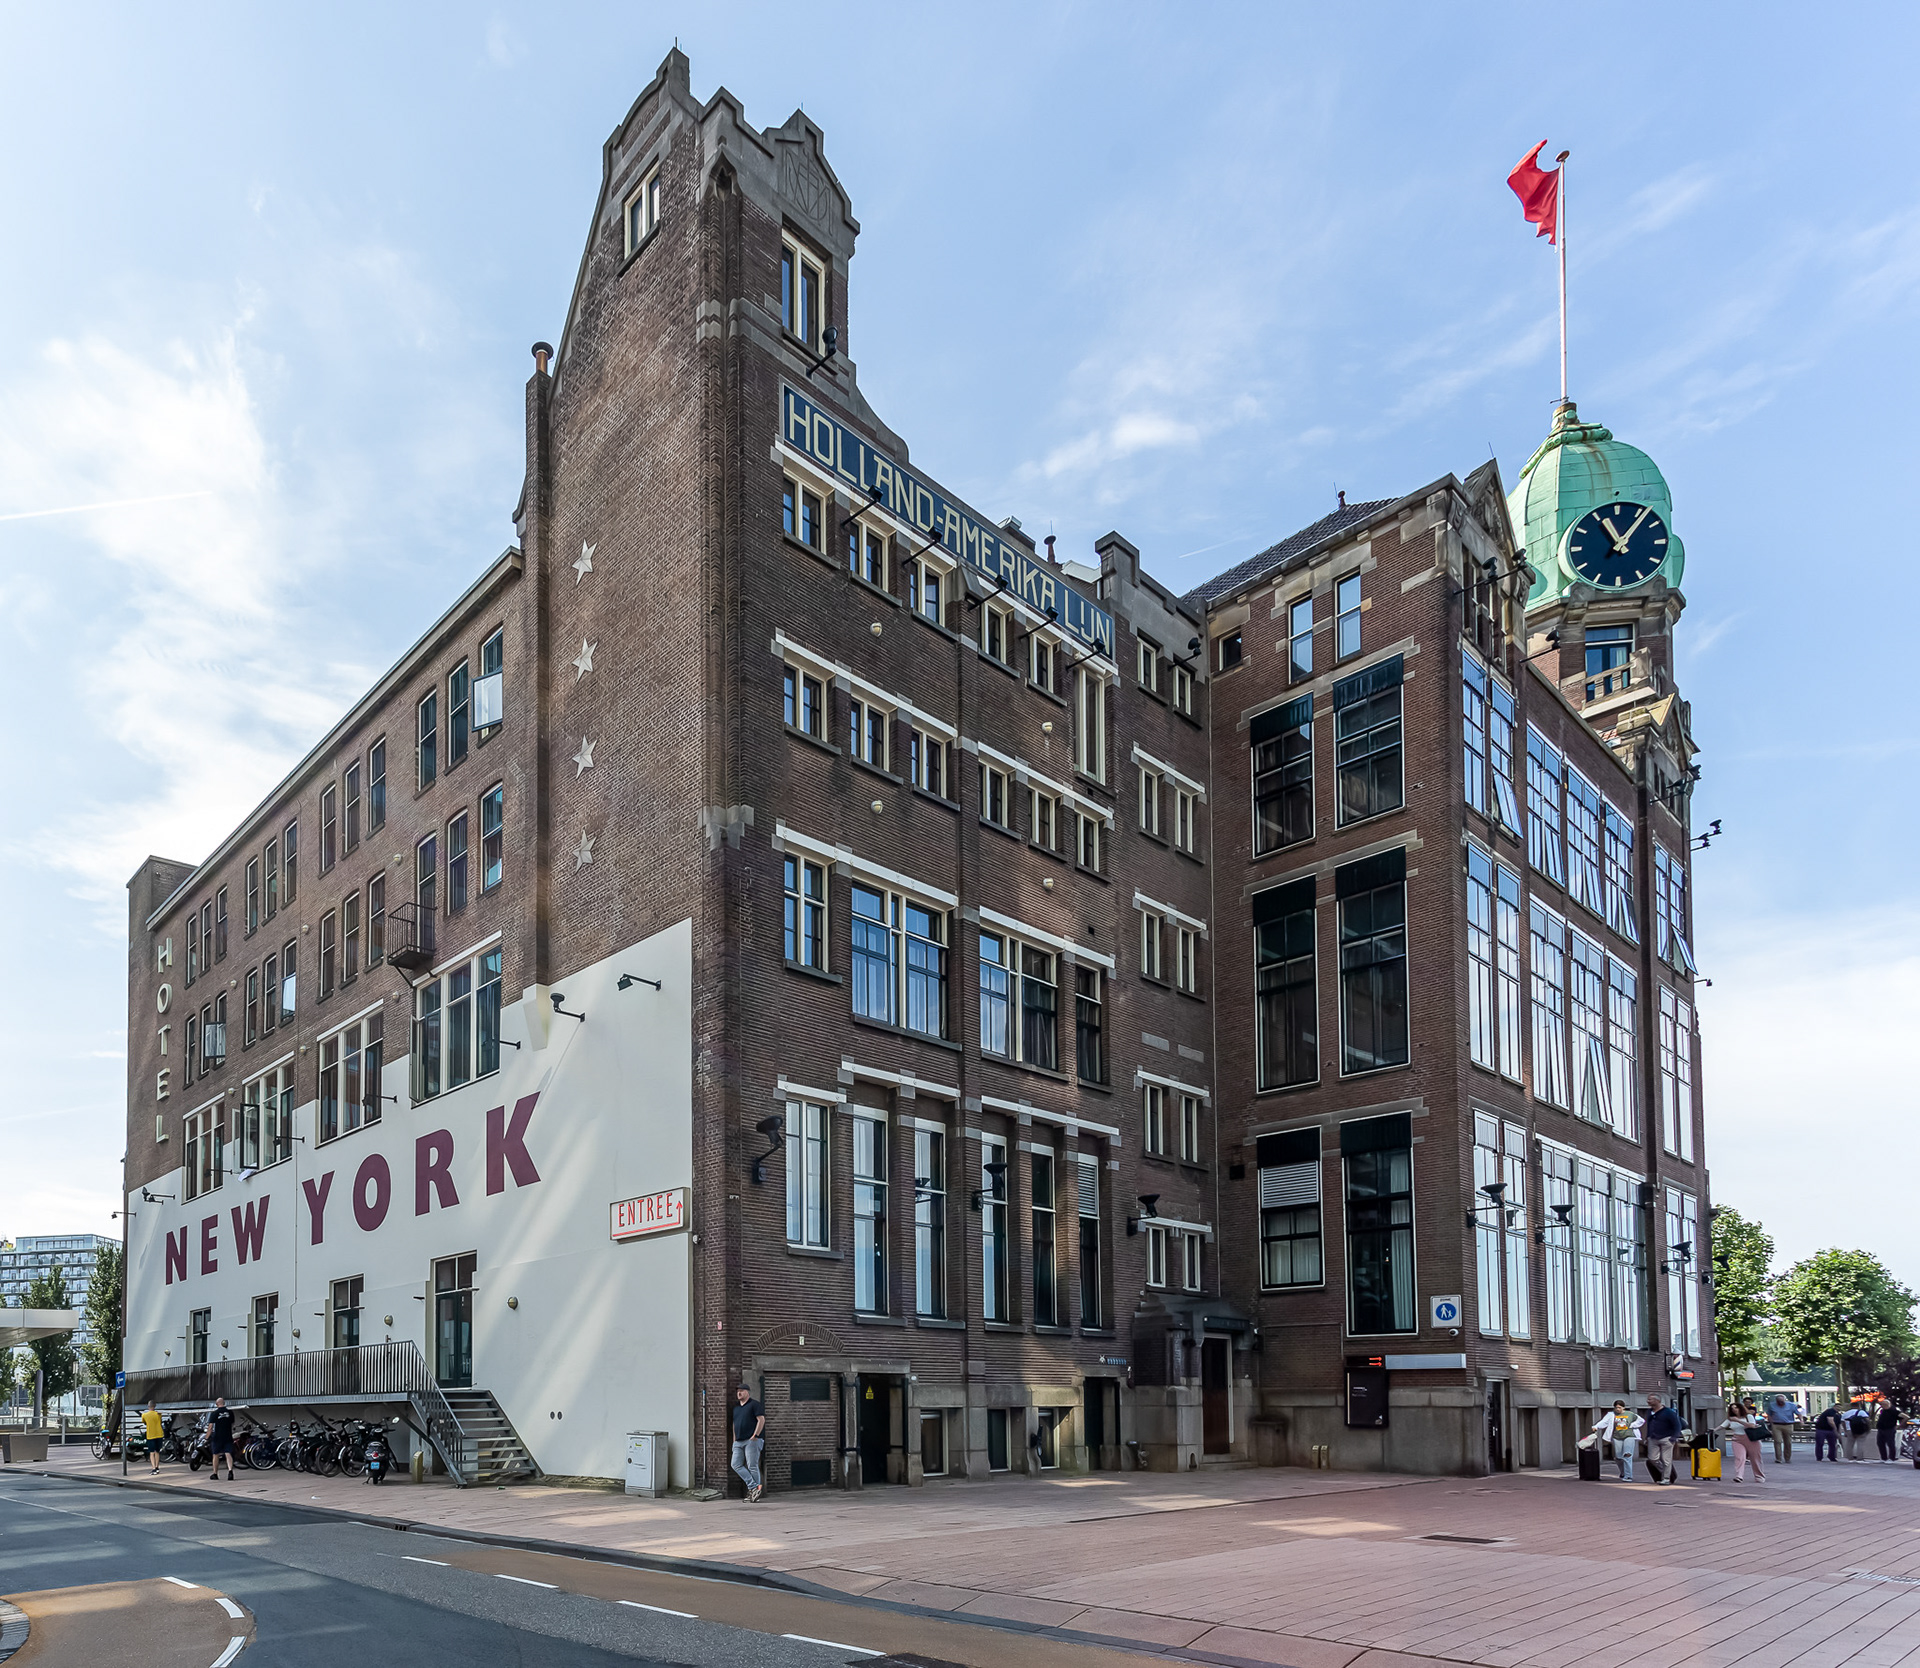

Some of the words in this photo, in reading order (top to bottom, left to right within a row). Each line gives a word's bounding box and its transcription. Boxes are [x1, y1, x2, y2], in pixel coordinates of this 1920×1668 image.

[156, 937, 173, 1144] HOTEL
[165, 1194, 271, 1286] NEW
[302, 1091, 541, 1246] YORK
[618, 1192, 673, 1227] ENTREE
